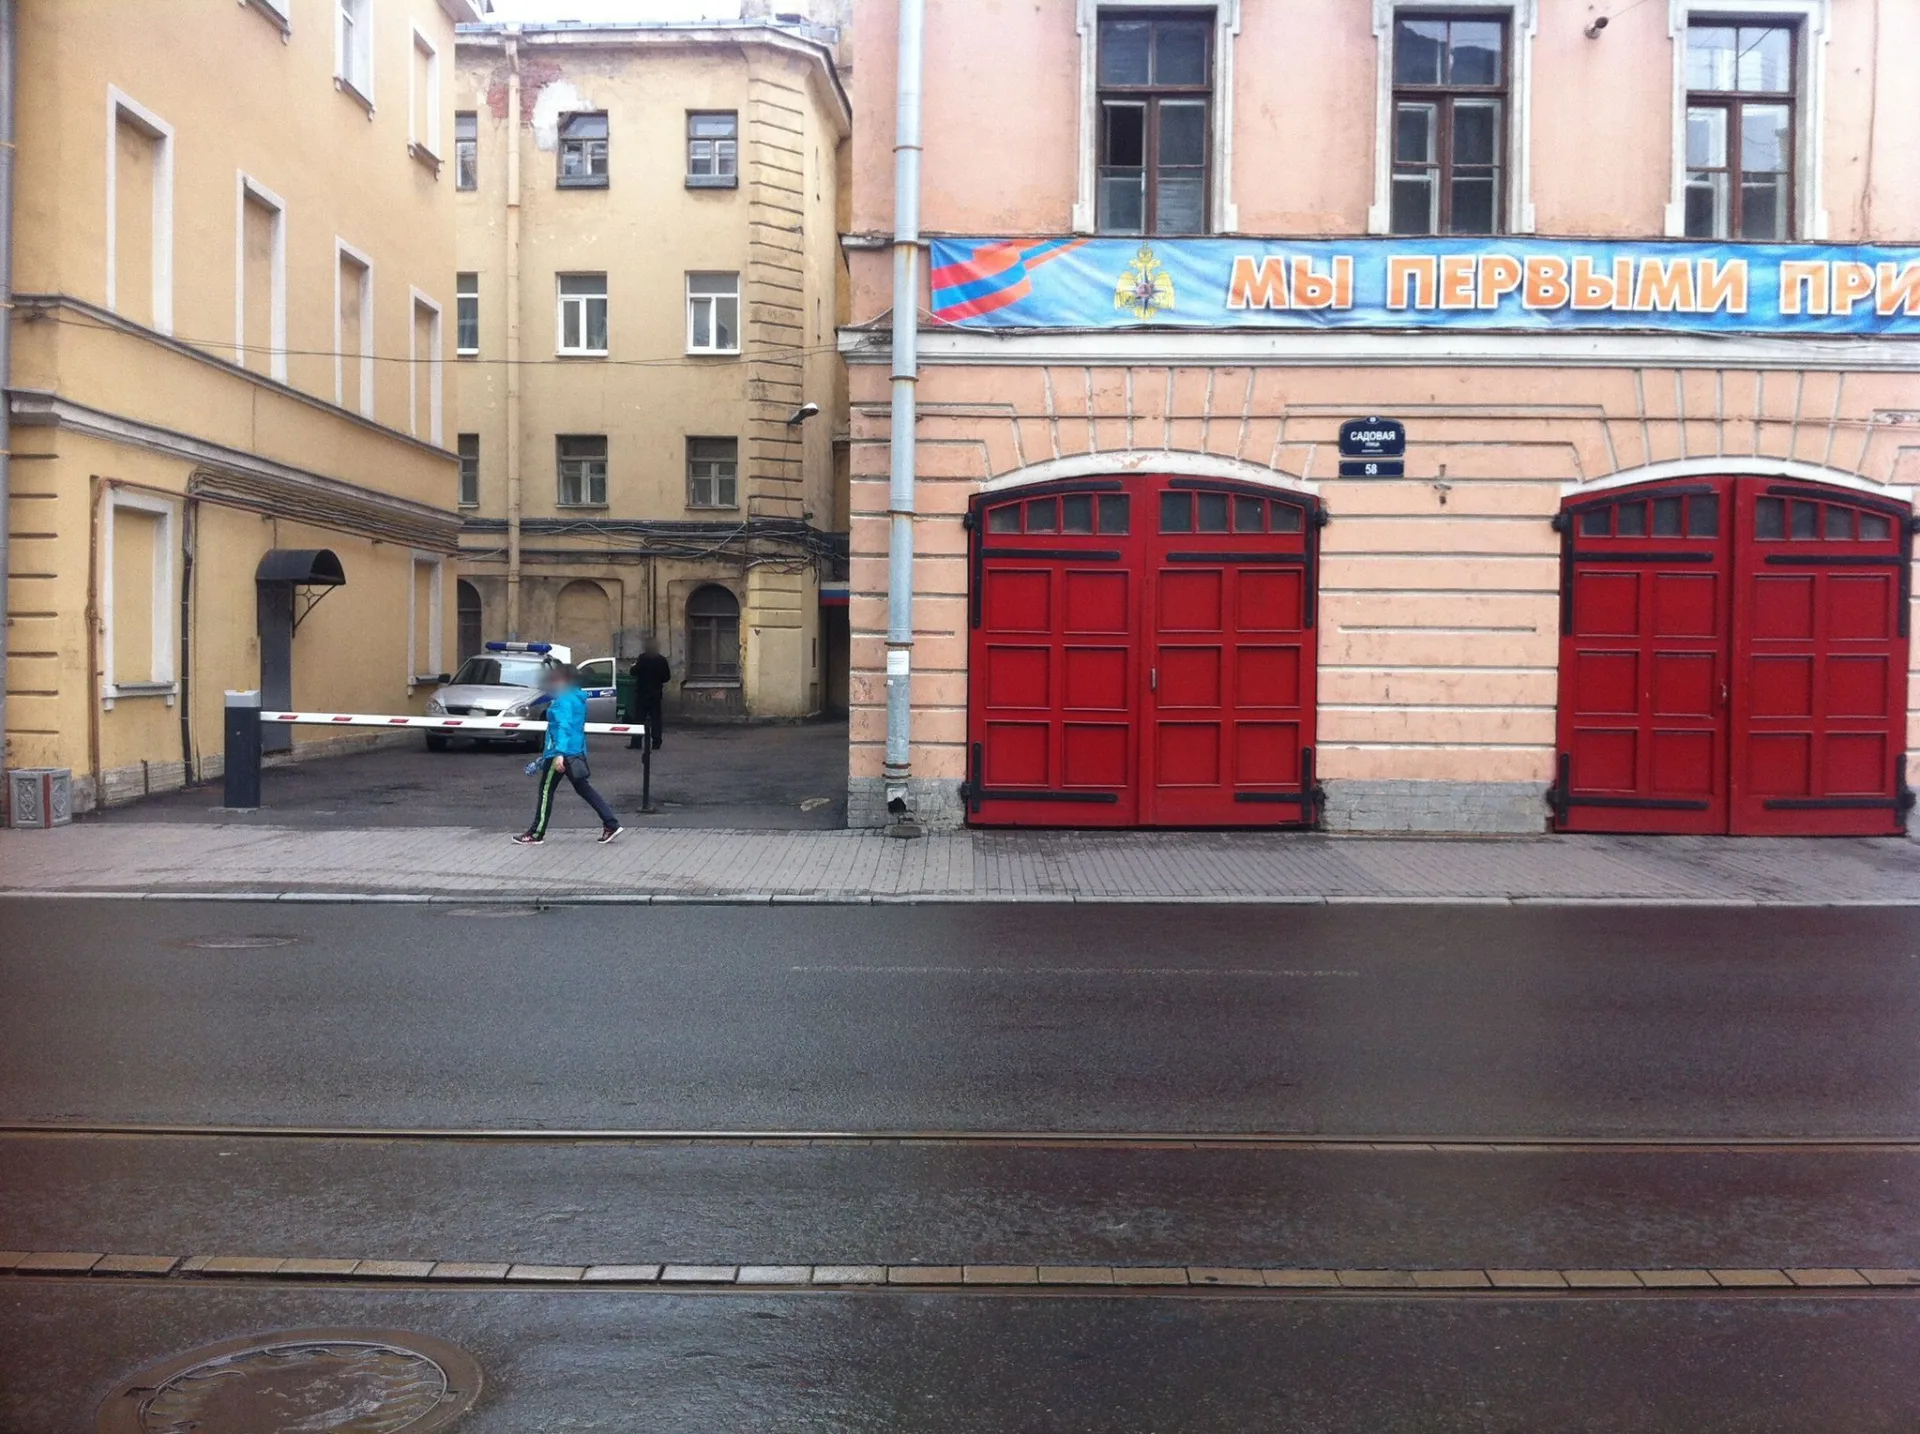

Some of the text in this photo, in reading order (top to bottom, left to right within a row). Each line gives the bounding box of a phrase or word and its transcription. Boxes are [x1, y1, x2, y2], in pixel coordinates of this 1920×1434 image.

[1227, 254, 1920, 316] МЫ ПЕРВЫМИ ПРИ
[1350, 430, 1396, 442] САДОВАЯ
[1365, 463, 1378, 475] 58
